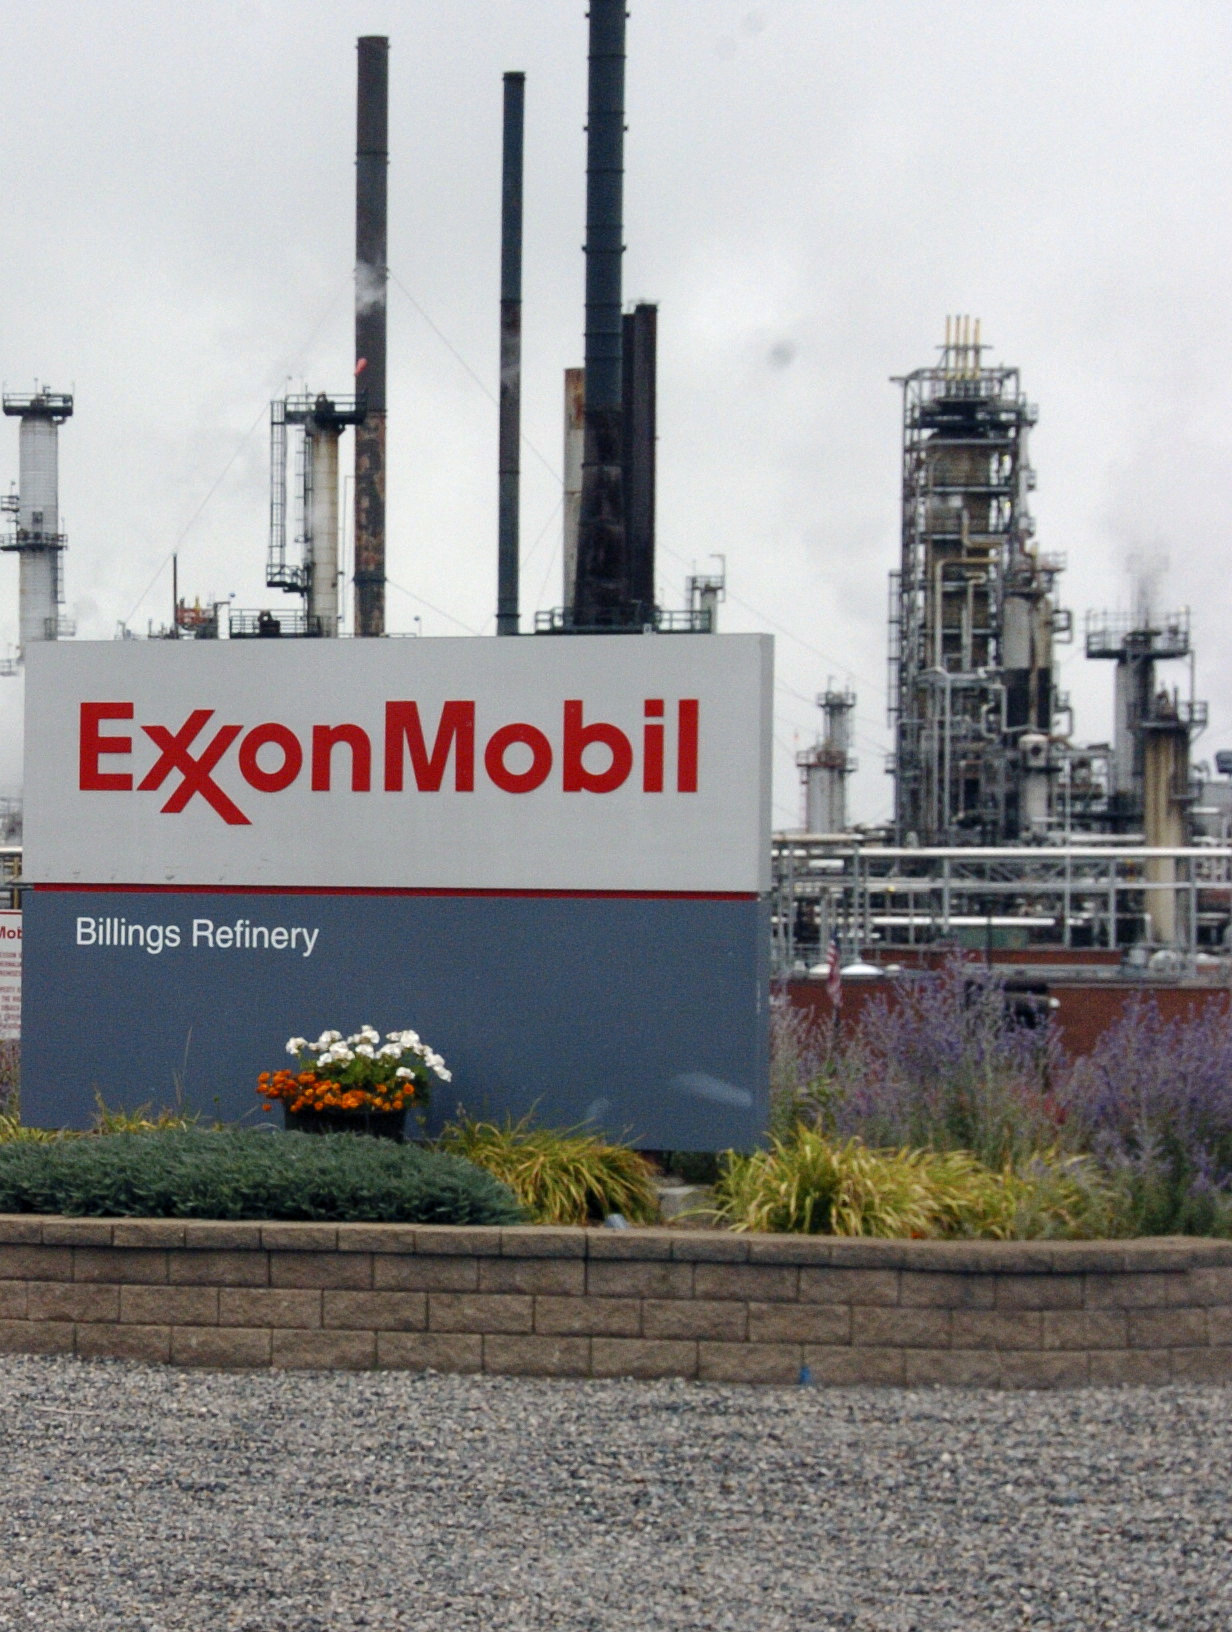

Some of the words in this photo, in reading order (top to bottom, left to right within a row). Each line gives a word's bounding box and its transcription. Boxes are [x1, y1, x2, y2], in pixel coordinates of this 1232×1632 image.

[79, 699, 699, 825] ExxonMobil
[76, 917, 181, 955] Billings
[192, 919, 320, 957] Refinery
